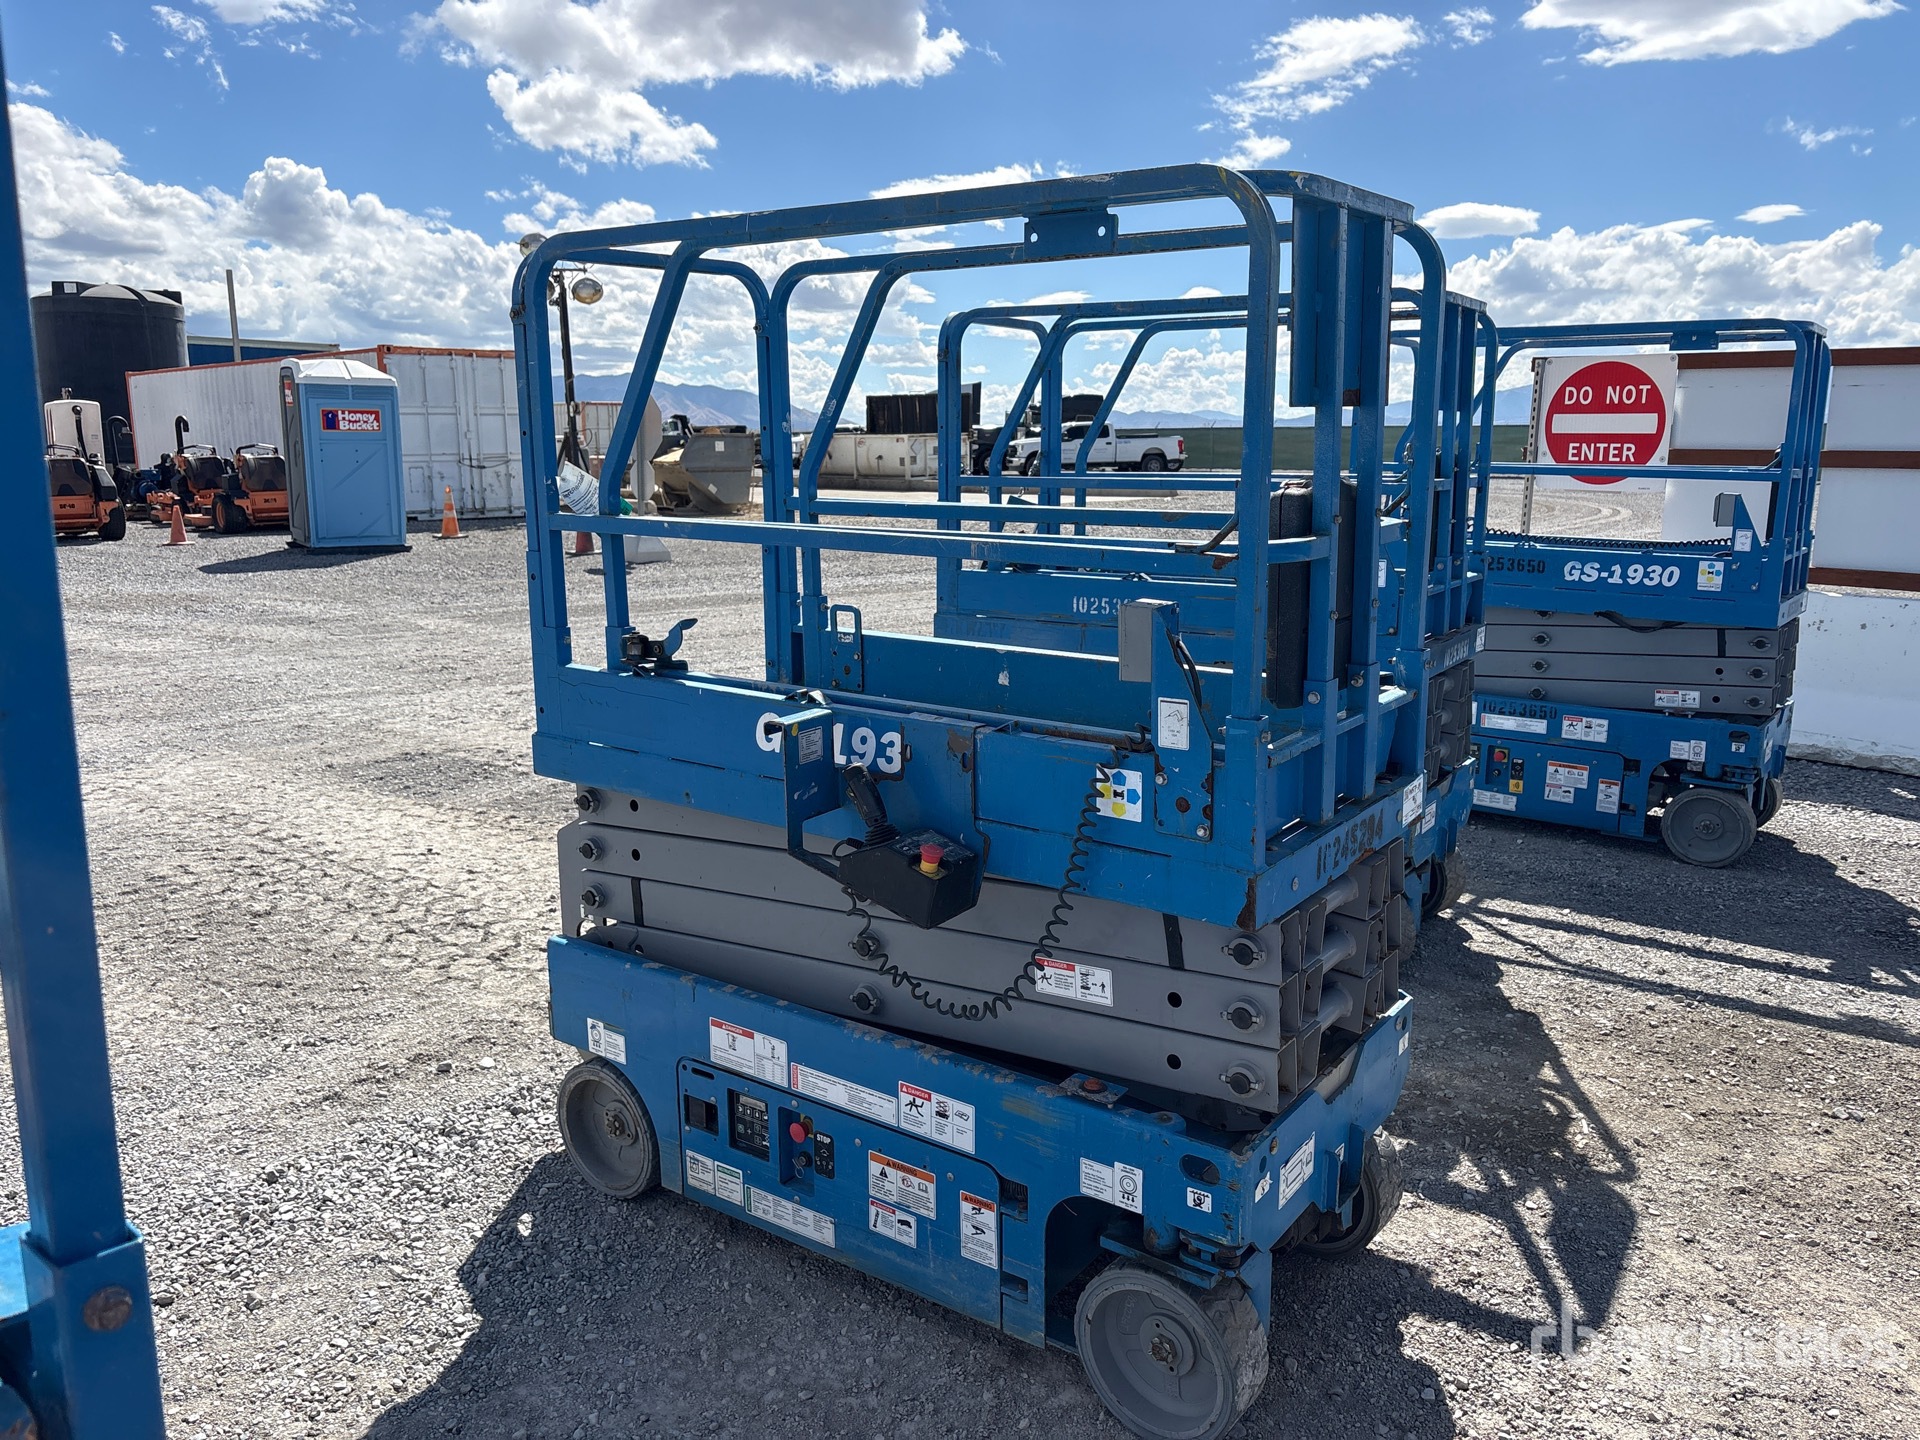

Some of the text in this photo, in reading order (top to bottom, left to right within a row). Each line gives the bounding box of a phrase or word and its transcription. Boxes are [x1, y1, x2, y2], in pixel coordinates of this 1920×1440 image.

[1564, 384, 1651, 405] DO NOT
[338, 410, 375, 422] Honey
[340, 420, 379, 431] Bucket
[1568, 443, 1636, 462] ENTER
[1563, 560, 1681, 588] GS-1930
[1072, 596, 1131, 615] 10253
[1049, 961, 1068, 969] DANGER
[907, 1087, 930, 1099] DANGER
[816, 1133, 831, 1144] STOP
[892, 1160, 918, 1176] WARNING
[969, 1196, 992, 1210] WARNING
